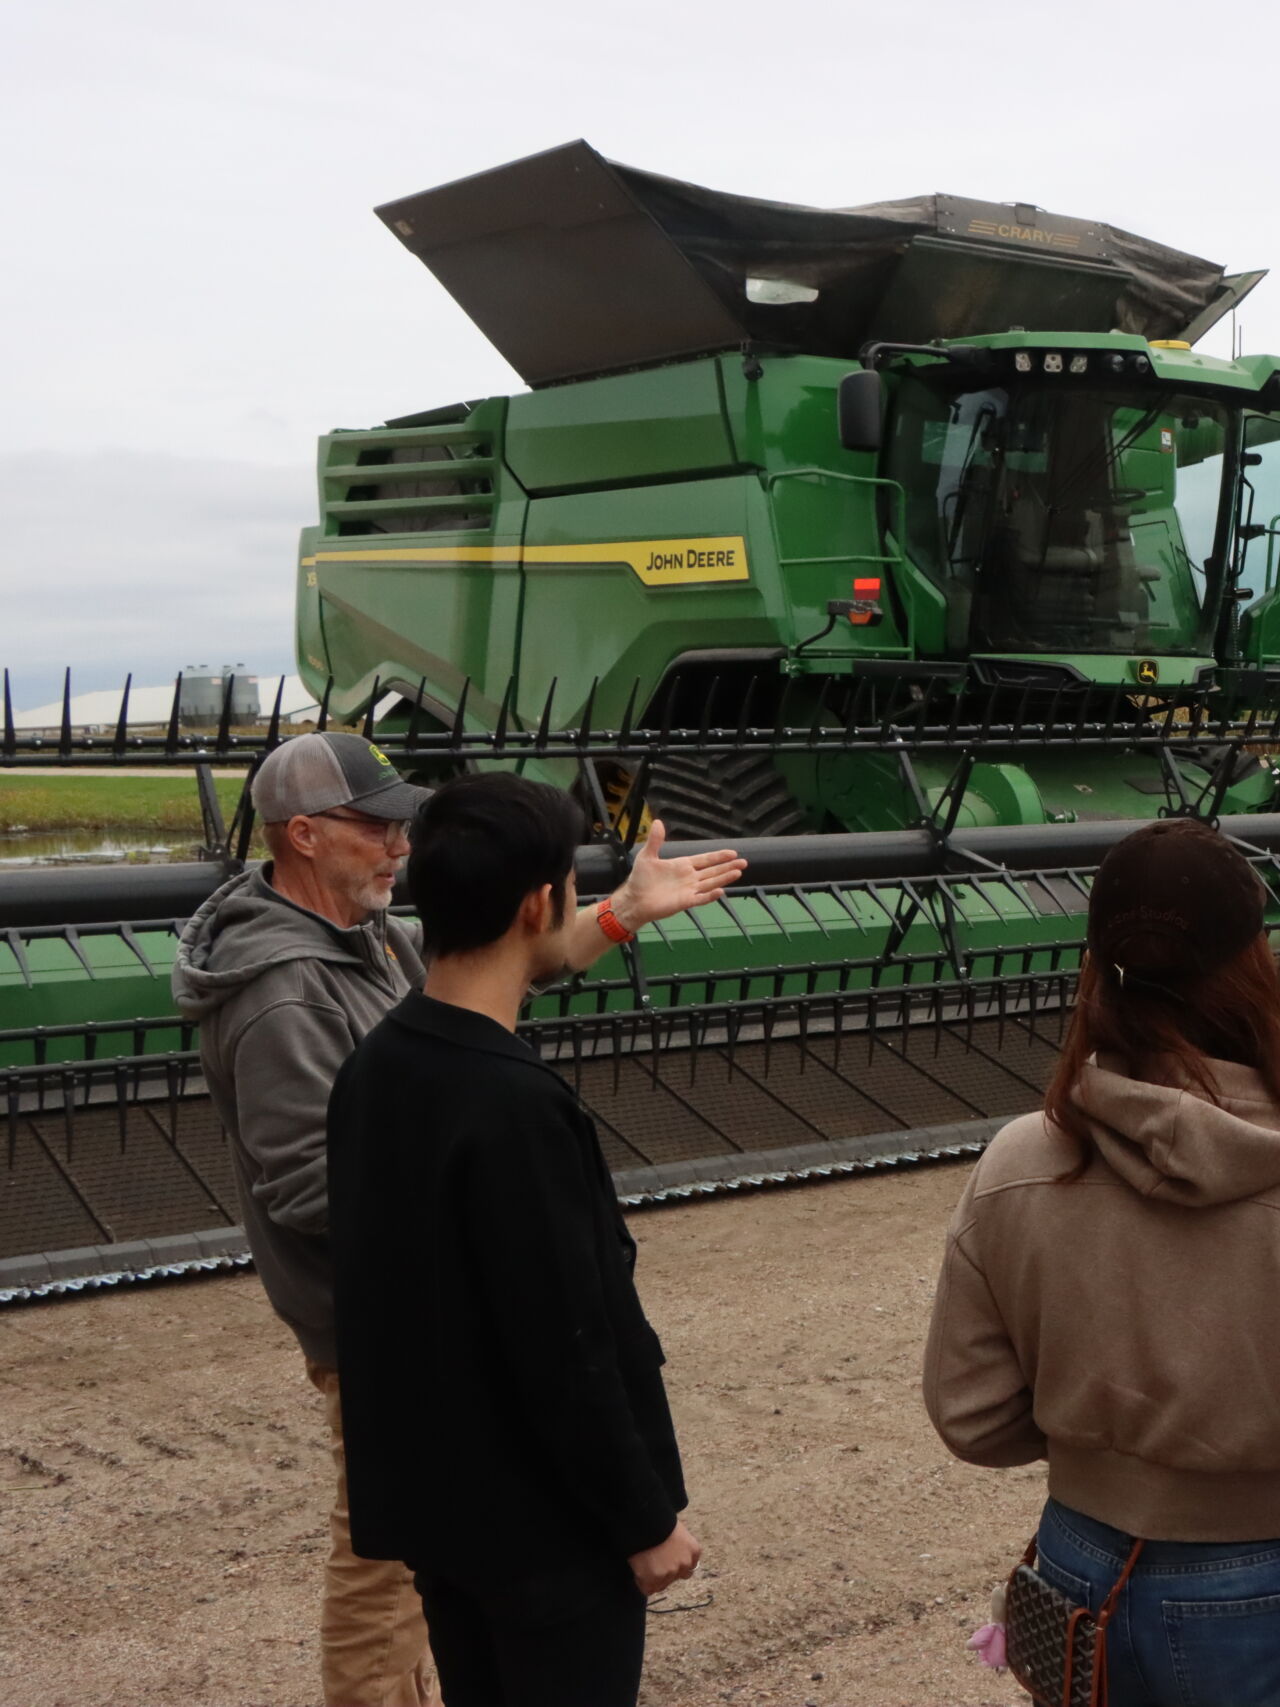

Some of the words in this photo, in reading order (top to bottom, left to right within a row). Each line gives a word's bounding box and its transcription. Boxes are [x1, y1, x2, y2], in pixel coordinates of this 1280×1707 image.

[997, 224, 1055, 244] CRARY
[646, 551, 684, 571] JOHN
[686, 549, 736, 568] DEERE
